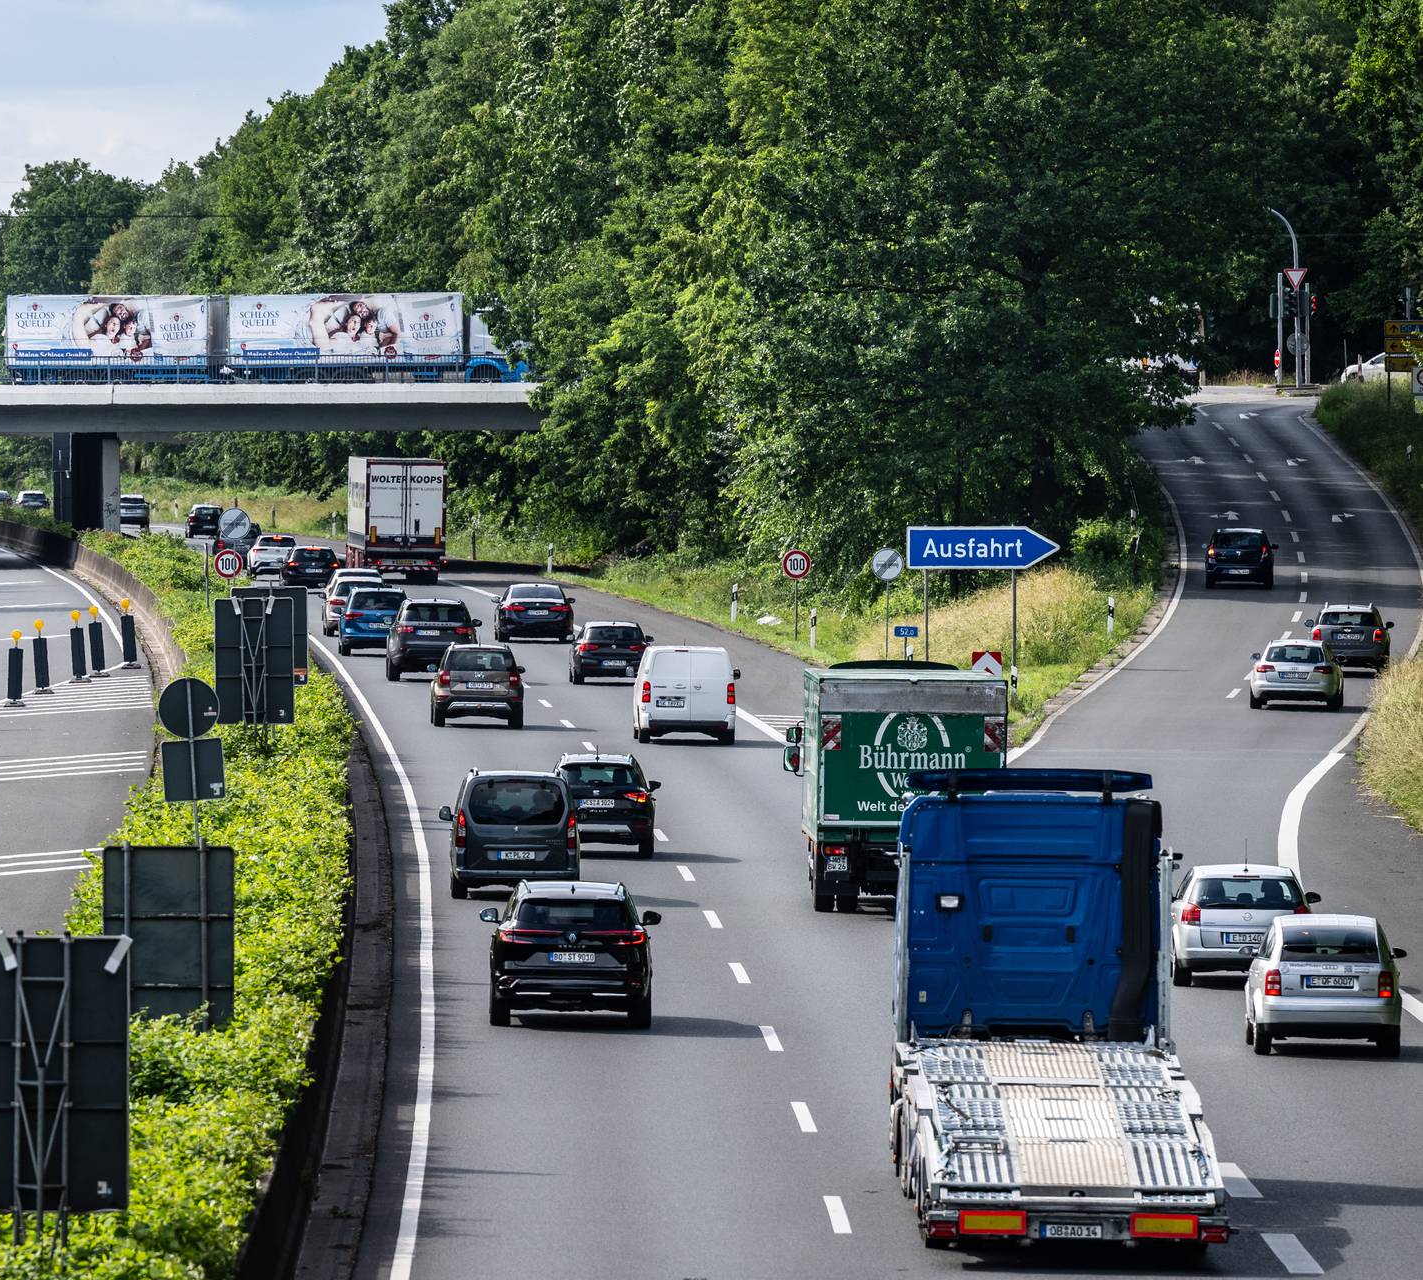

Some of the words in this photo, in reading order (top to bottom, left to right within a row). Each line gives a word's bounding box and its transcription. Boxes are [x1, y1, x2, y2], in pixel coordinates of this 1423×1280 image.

[15, 312, 56, 320] SCHLOSS
[240, 311, 280, 319] SCHLOSS
[17, 320, 52, 329] QUELLE
[159, 321, 196, 331] SCHLOSS
[241, 319, 277, 328] QUELLE
[409, 320, 447, 331] SCHLOSS
[162, 329, 194, 342] QUELLE
[412, 328, 445, 341] QUELLE
[371, 475, 408, 484] WOLTER
[409, 475, 443, 484] KOOPS
[922, 537, 1023, 558] Ausfahrt
[220, 557, 237, 571] 100
[788, 558, 805, 571] 100
[858, 744, 966, 770] Bührmann
[857, 801, 887, 812] Welt
[1232, 934, 1237, 942] E
[1242, 934, 1248, 942] D
[1311, 977, 1317, 985] E
[1321, 977, 1332, 985] QF
[1333, 977, 1353, 985] 6007
[1049, 1225, 1063, 1236] OB
[1085, 1226, 1098, 1237] 14
